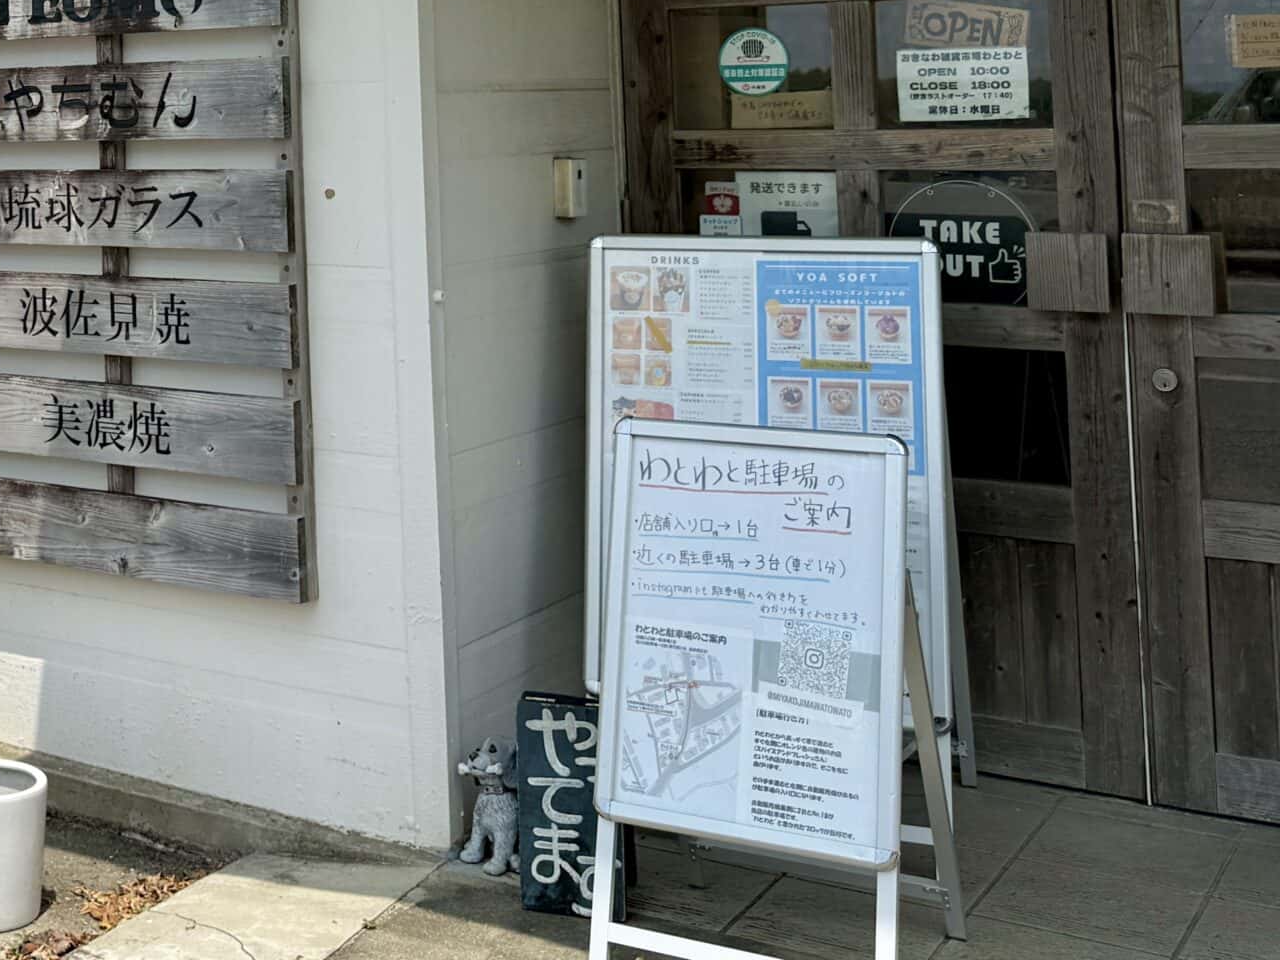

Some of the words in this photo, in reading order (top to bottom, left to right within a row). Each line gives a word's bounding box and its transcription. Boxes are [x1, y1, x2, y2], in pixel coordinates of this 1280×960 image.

[923, 11, 1005, 46] OPEN
[909, 81, 958, 91] CLOSE
[970, 80, 1011, 90] 18:00
[917, 67, 957, 77] OPEN
[970, 66, 1010, 76] 10:00
[3, 72, 197, 132] やちむん
[750, 181, 823, 195] 発送できます
[4, 182, 205, 234] 琉球ガラス
[920, 219, 1000, 245] TAKE
[651, 256, 700, 265] DRINKS
[797, 272, 827, 282] YOA
[838, 272, 878, 283] SOFT
[41, 394, 172, 456] 美濃焼
[639, 449, 845, 490] わとわと駐車場の
[783, 496, 852, 529] ご案内
